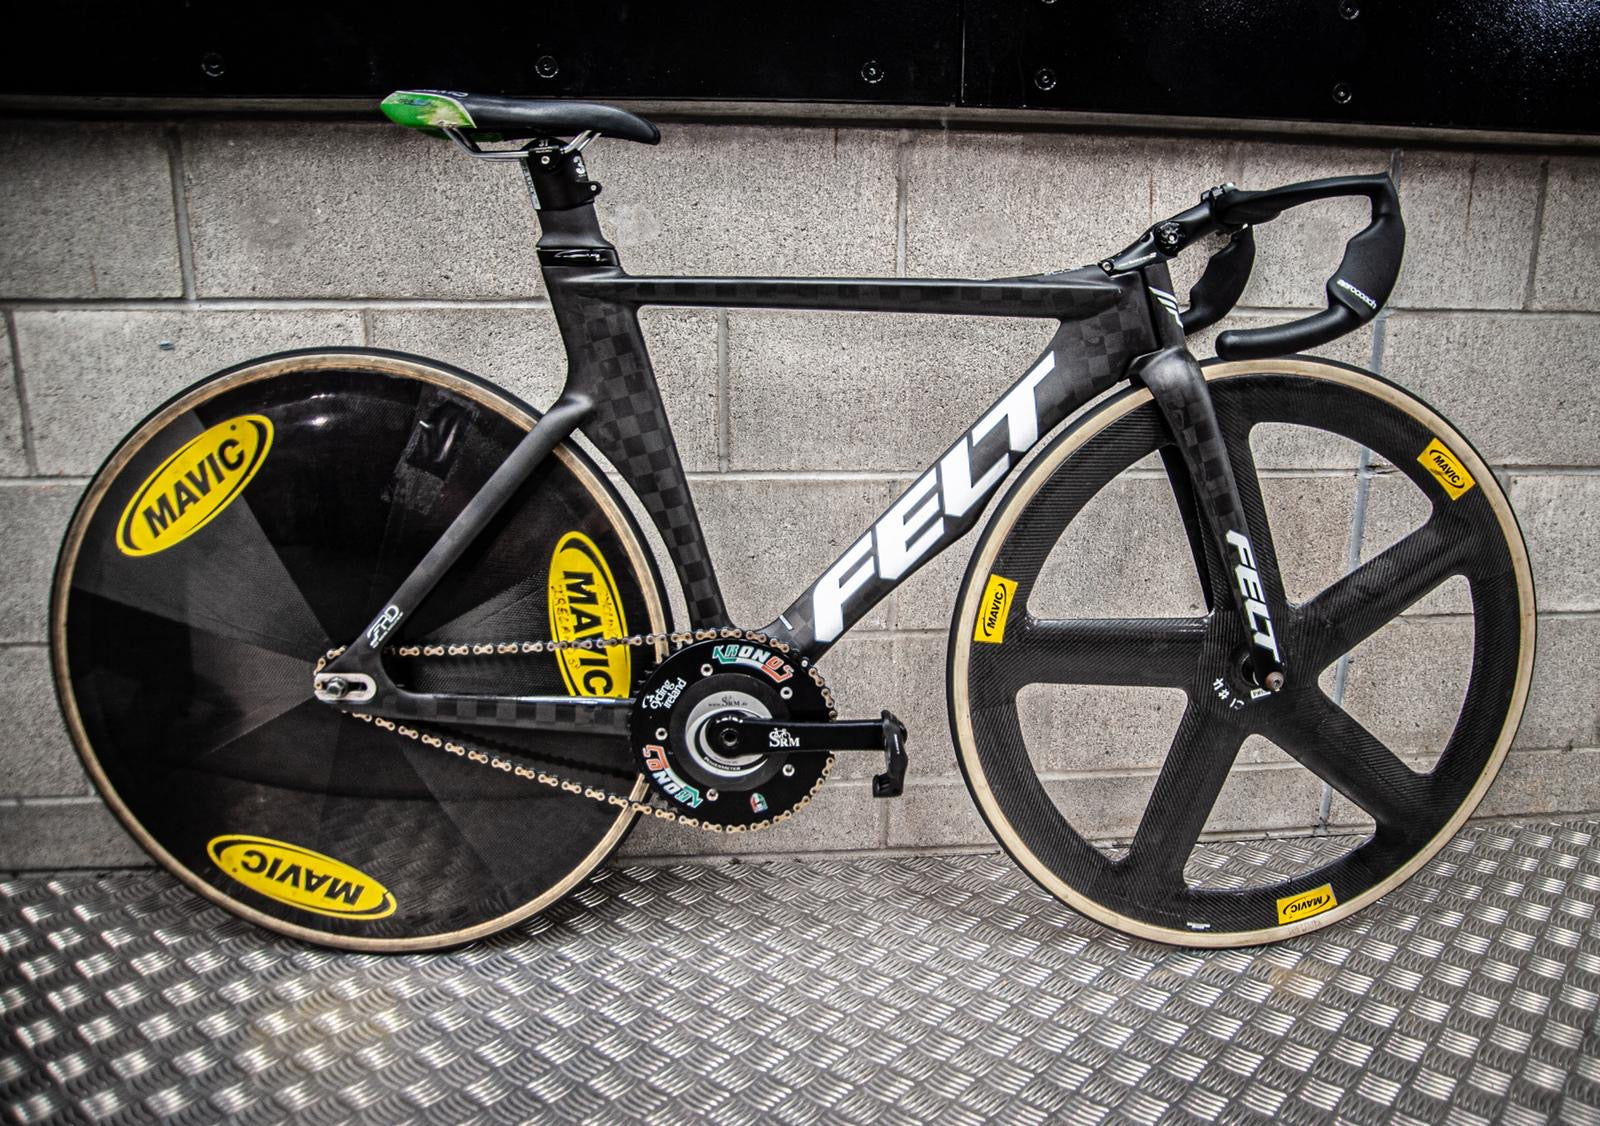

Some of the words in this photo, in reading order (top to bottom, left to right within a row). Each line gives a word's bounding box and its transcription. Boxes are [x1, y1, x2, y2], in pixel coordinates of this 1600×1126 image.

[143, 438, 245, 539] MAVIC
[813, 351, 1055, 642] FELT
[1433, 455, 1460, 483] MAVIC
[987, 591, 1003, 629] MAVIC
[1226, 529, 1280, 662] FELT
[563, 571, 614, 696] MAVIC
[712, 645, 794, 683] KRONOS
[769, 729, 800, 747] SRM
[643, 744, 703, 808] KRONOS
[240, 850, 365, 906] MAVIC
[1291, 895, 1323, 913] MAVIC
